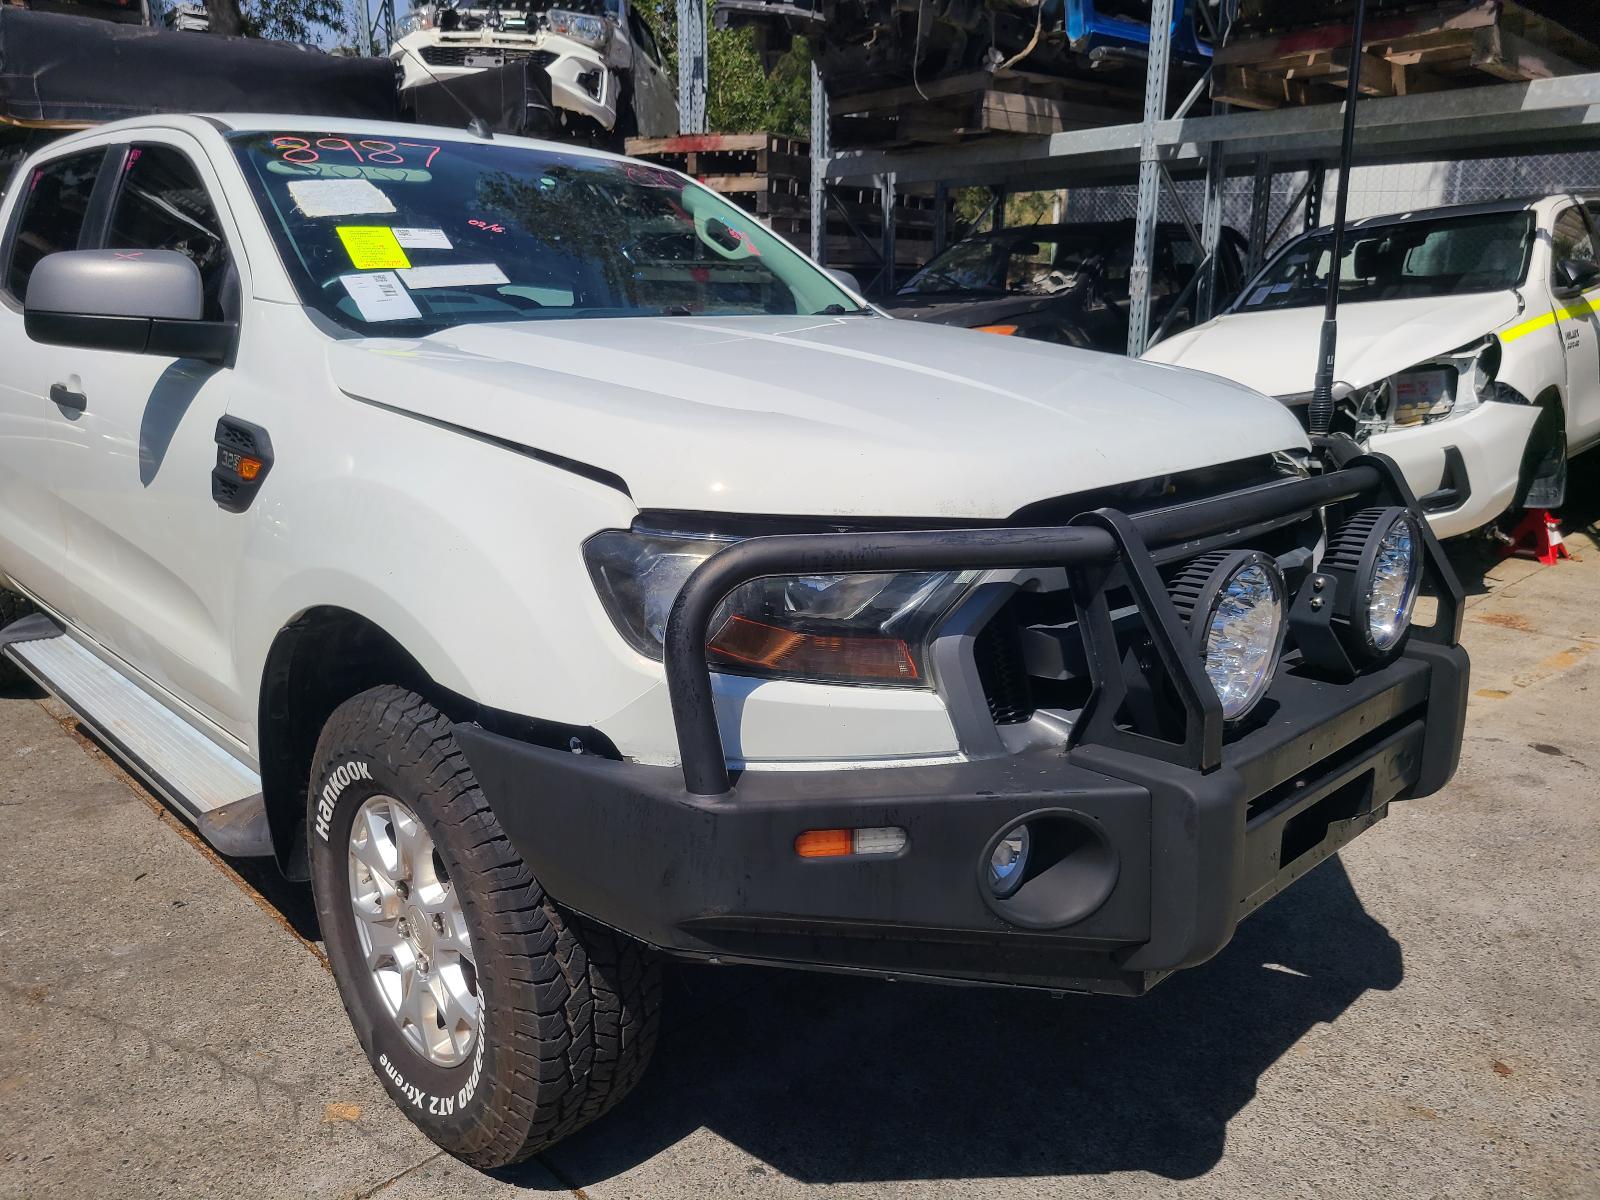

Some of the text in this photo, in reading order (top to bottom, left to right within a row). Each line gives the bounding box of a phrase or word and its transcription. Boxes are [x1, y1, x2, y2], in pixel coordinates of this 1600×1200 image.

[272, 136, 441, 169] 8987
[379, 1053, 426, 1109] Xtreme
[429, 1095, 455, 1116] AT2
